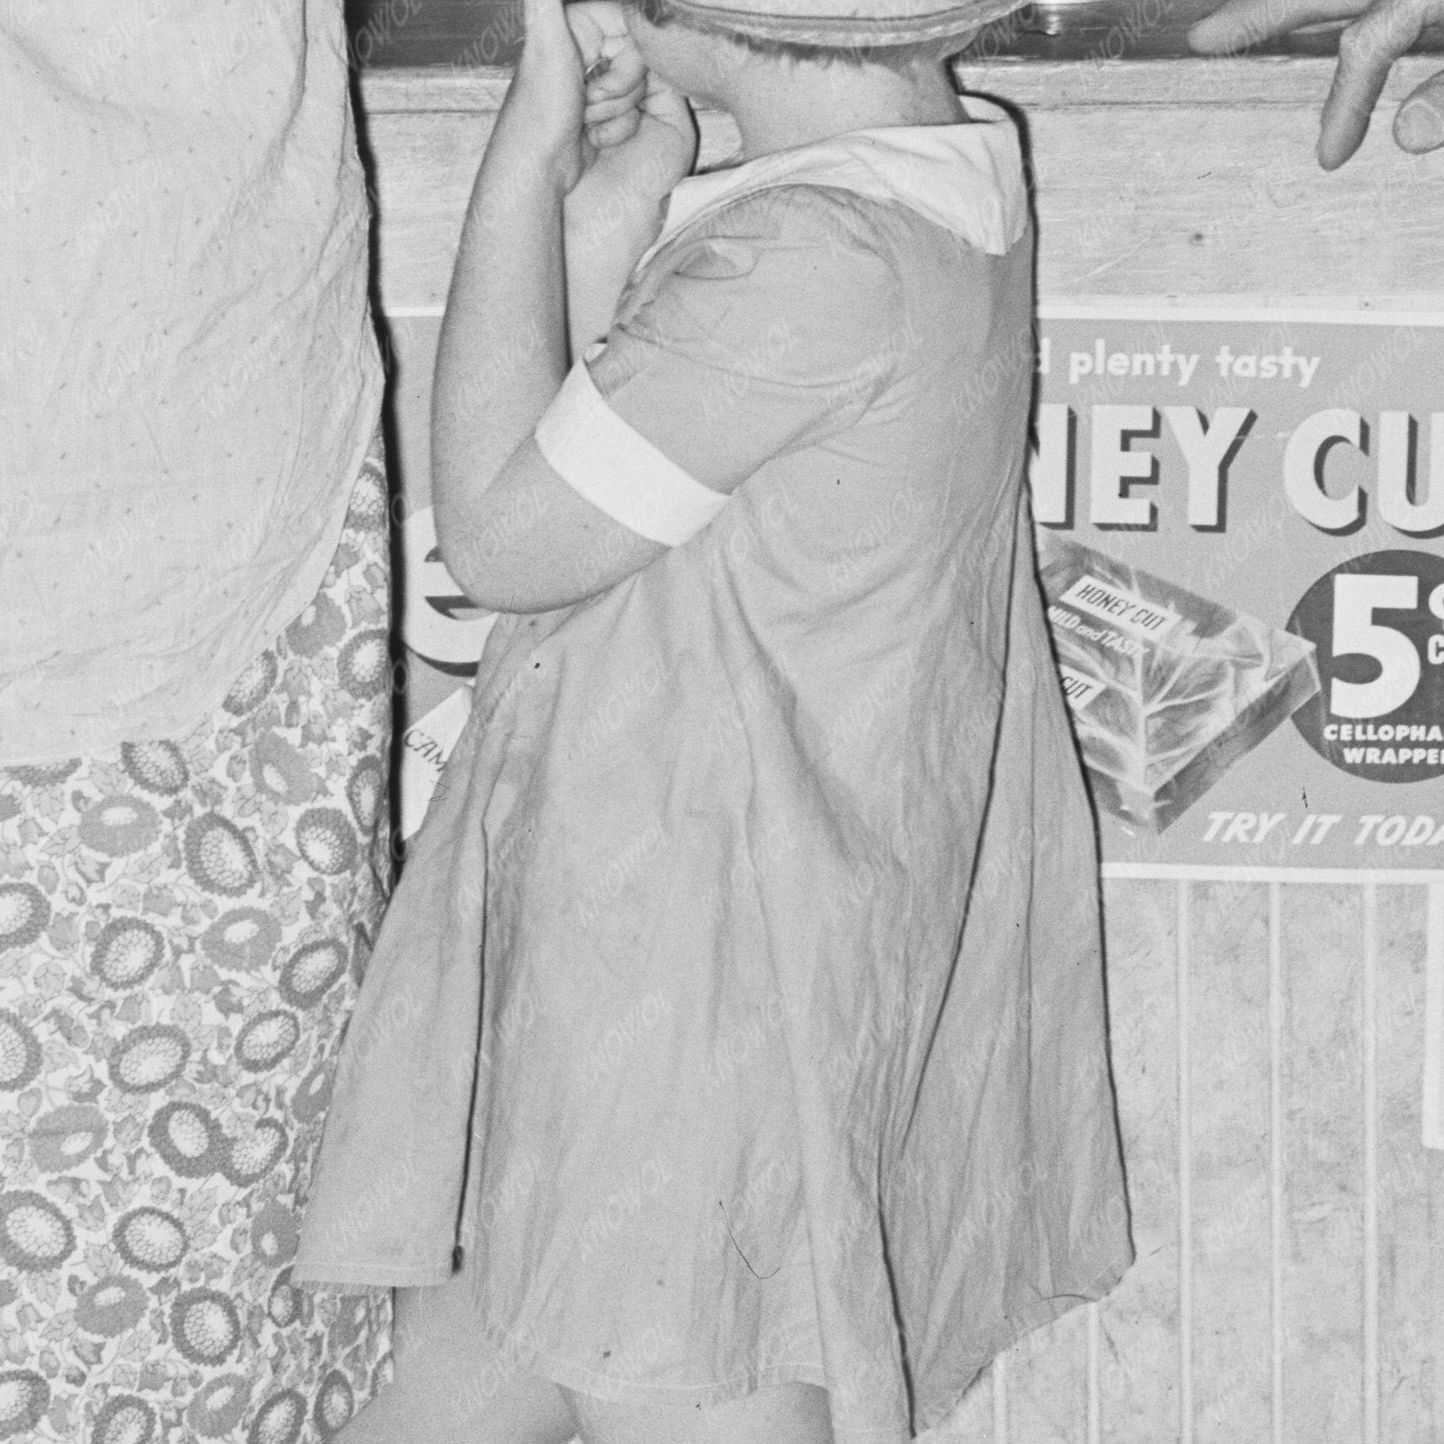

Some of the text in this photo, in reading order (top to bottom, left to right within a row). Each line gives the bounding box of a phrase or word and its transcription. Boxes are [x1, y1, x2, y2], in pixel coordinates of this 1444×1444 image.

[1068, 338, 1200, 385] plenty
[1216, 345, 1322, 388] tasty
[1076, 583, 1167, 632] HONEY CUT
[1076, 623, 1104, 643] and
[1203, 811, 1286, 845] TRY
[1293, 814, 1343, 846] IT
